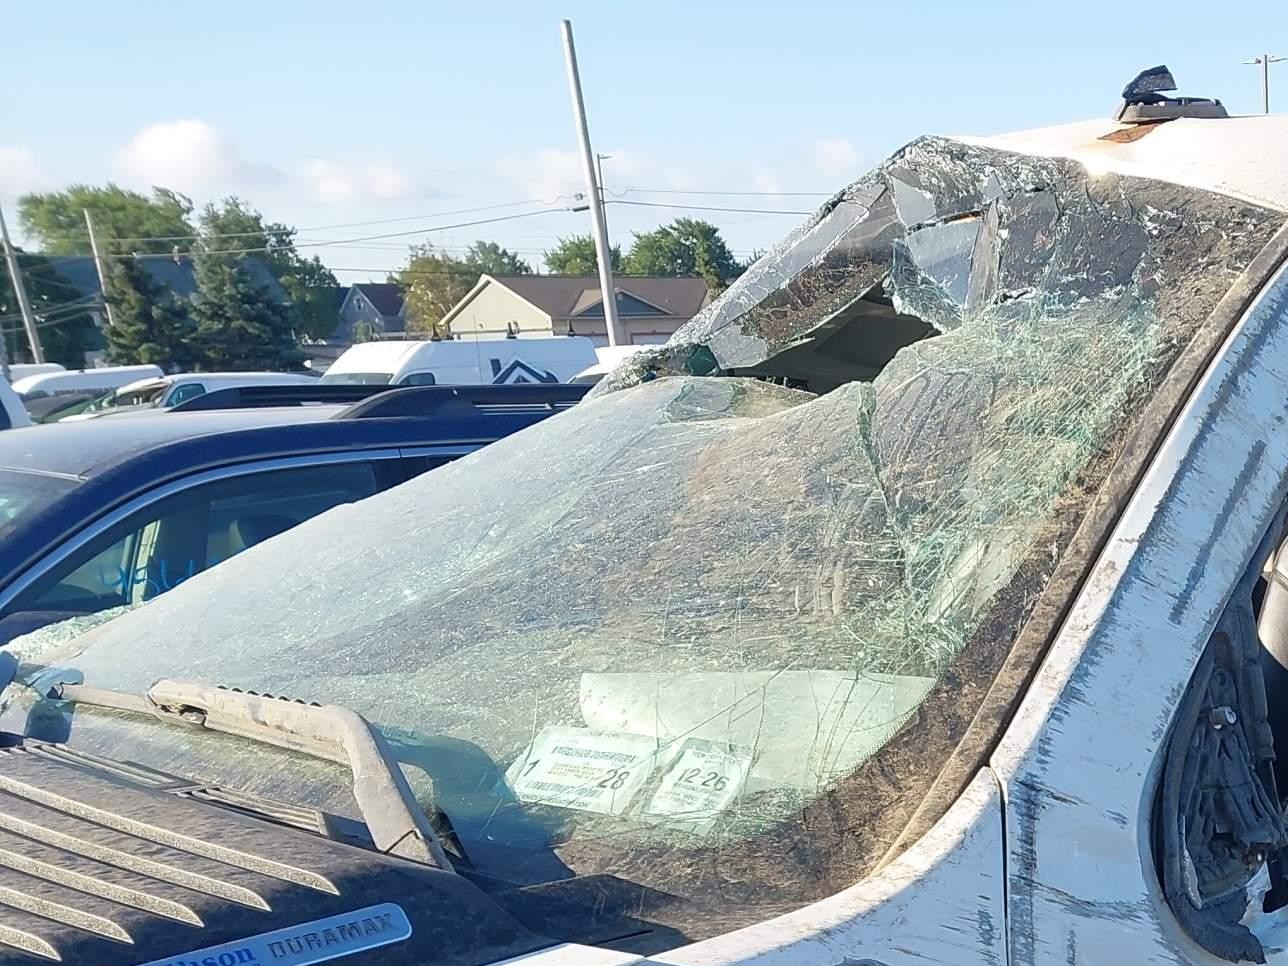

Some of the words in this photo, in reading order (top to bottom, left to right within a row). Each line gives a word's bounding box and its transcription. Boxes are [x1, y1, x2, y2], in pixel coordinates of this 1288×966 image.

[596, 768, 631, 790] 28
[677, 767, 730, 792] 12-26
[268, 912, 396, 960] DURAMAX
